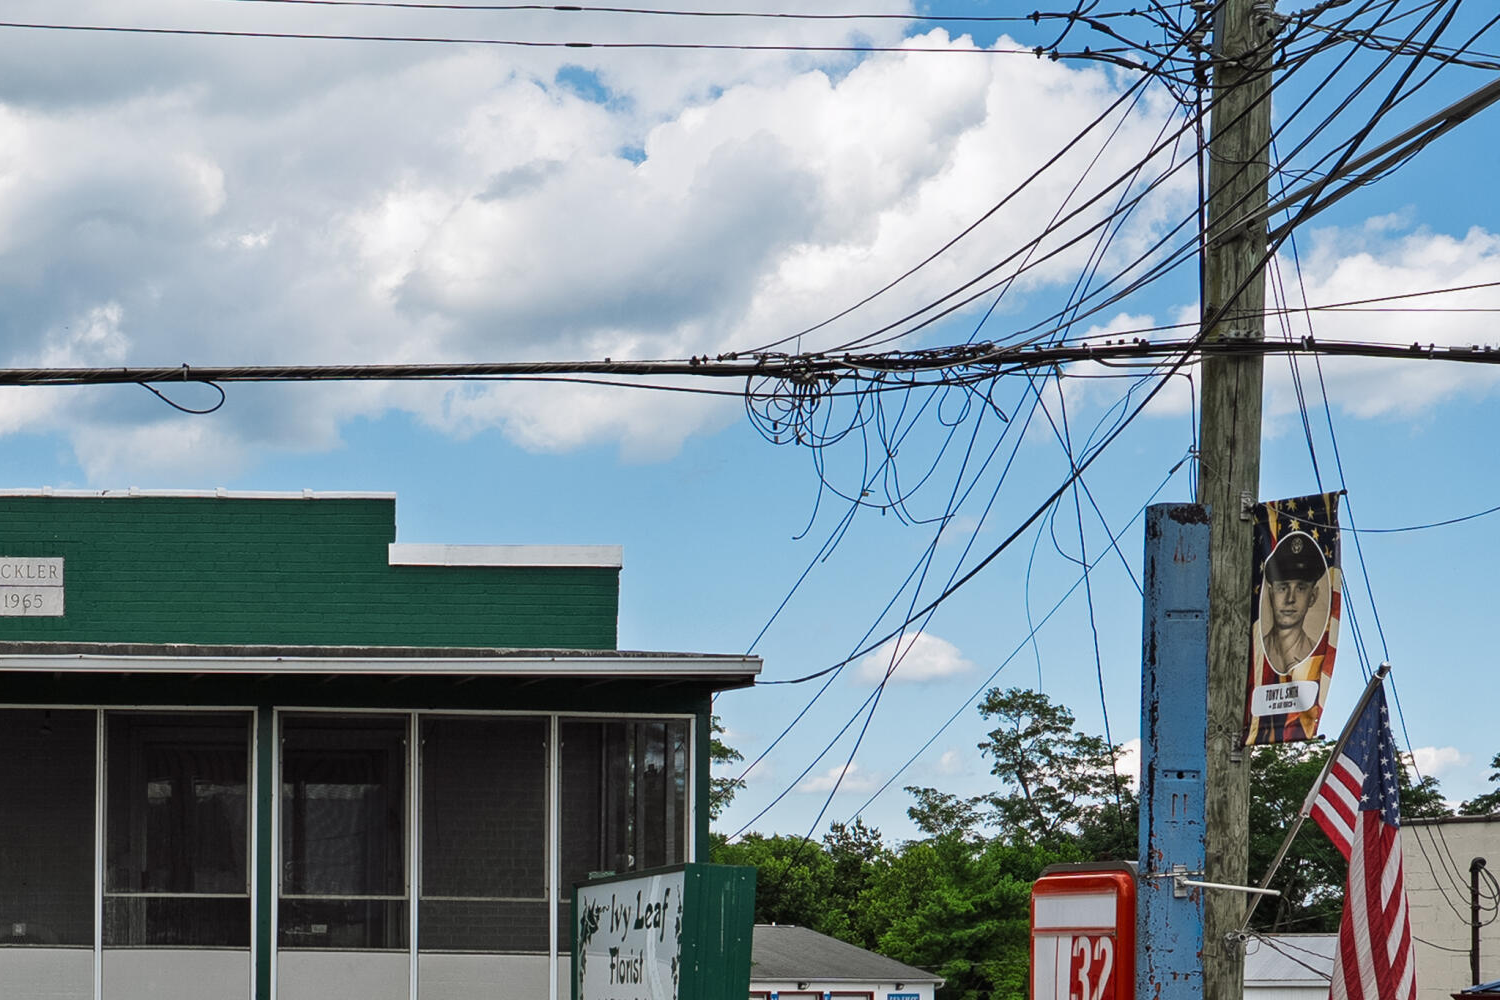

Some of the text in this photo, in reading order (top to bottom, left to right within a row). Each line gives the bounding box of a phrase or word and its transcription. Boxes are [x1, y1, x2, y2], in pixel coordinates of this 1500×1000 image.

[4, 593, 43, 609] 1965
[610, 887, 670, 943] Ivy Leaf
[609, 946, 644, 985] Florist
